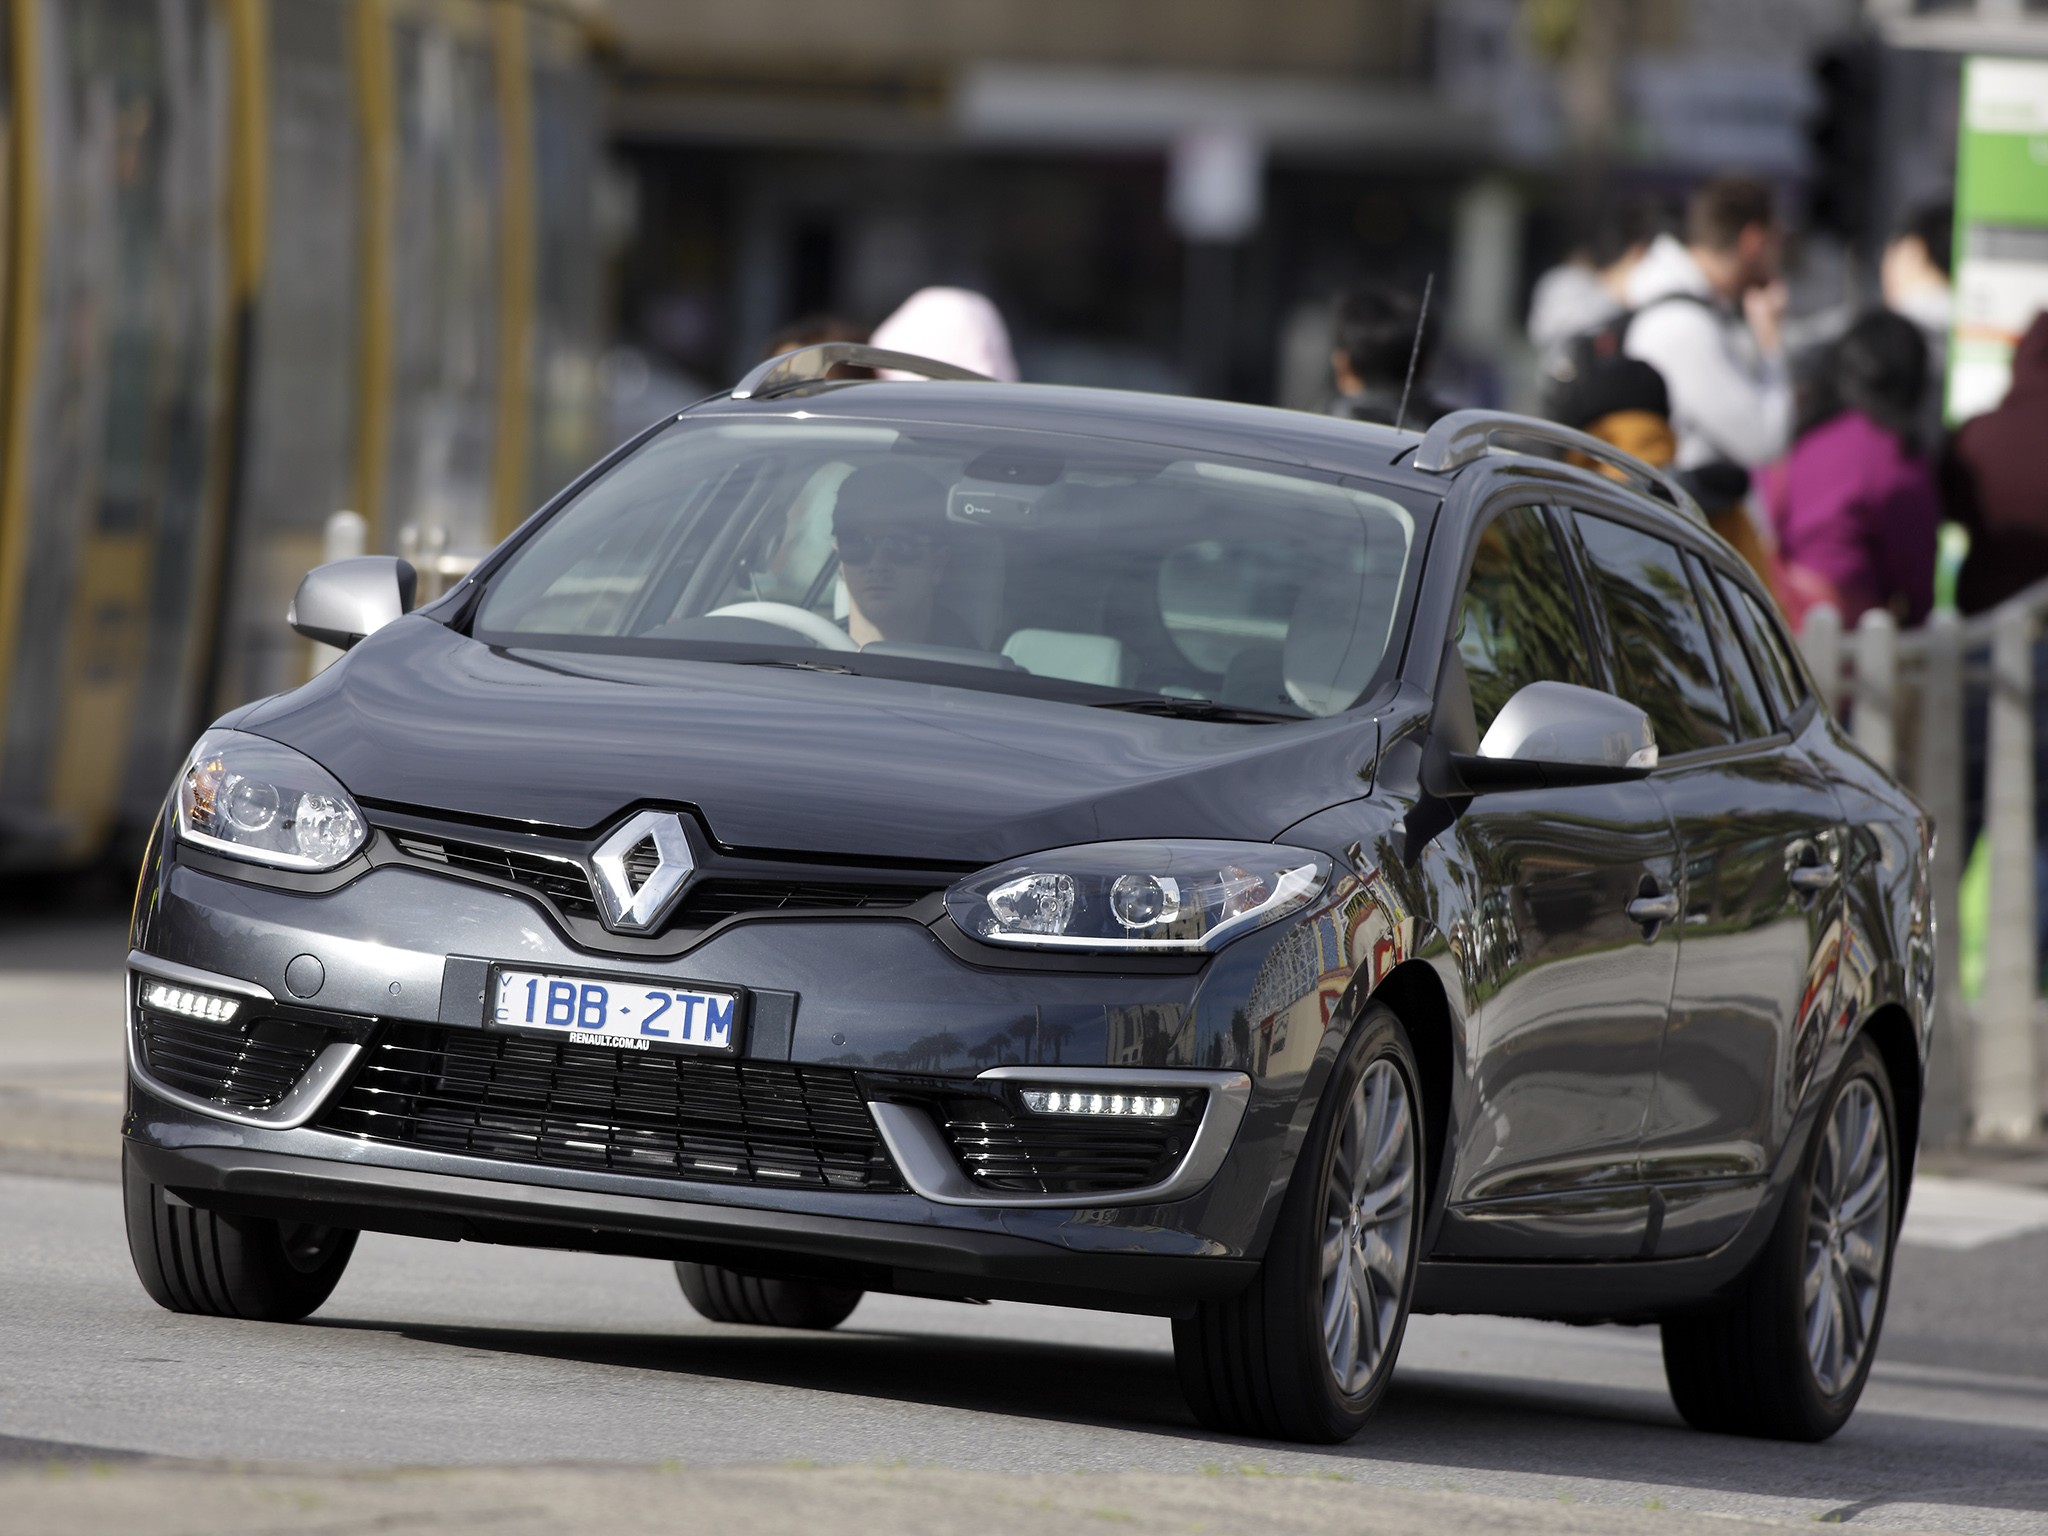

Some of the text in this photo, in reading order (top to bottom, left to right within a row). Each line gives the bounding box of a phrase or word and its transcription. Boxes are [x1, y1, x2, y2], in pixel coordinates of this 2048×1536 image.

[495, 974, 513, 1020] VIC
[525, 978, 735, 1044] 1BB 2TM
[569, 1032, 650, 1051] RENAULT.COM.AU
